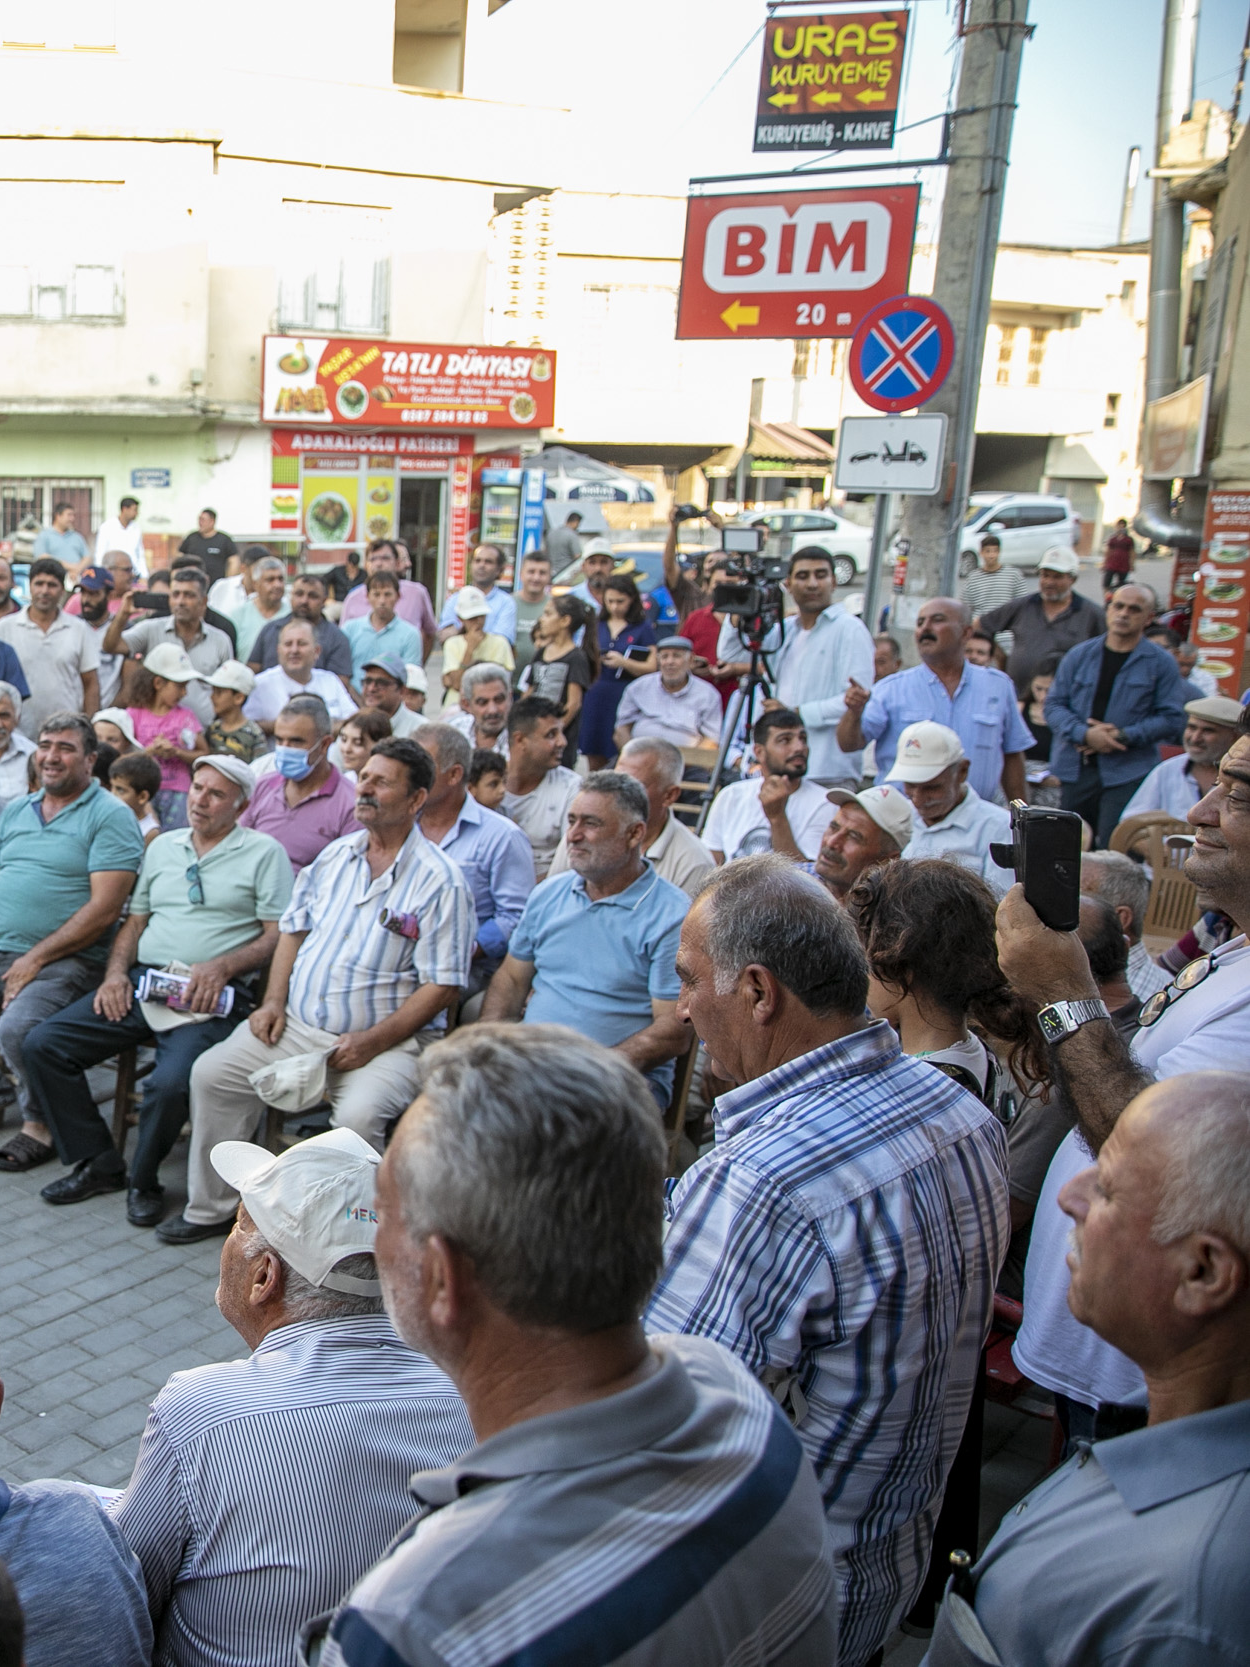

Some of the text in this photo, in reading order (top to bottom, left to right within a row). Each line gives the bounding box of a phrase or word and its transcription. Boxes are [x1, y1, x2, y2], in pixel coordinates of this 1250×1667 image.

[773, 21, 899, 59] URAS
[770, 59, 893, 88] KURUYEMİŞ
[757, 119, 892, 146] KURUYEMİŞ KAHVE
[795, 302, 826, 326] 20
[381, 348, 532, 377] TATLI DÜNYASI
